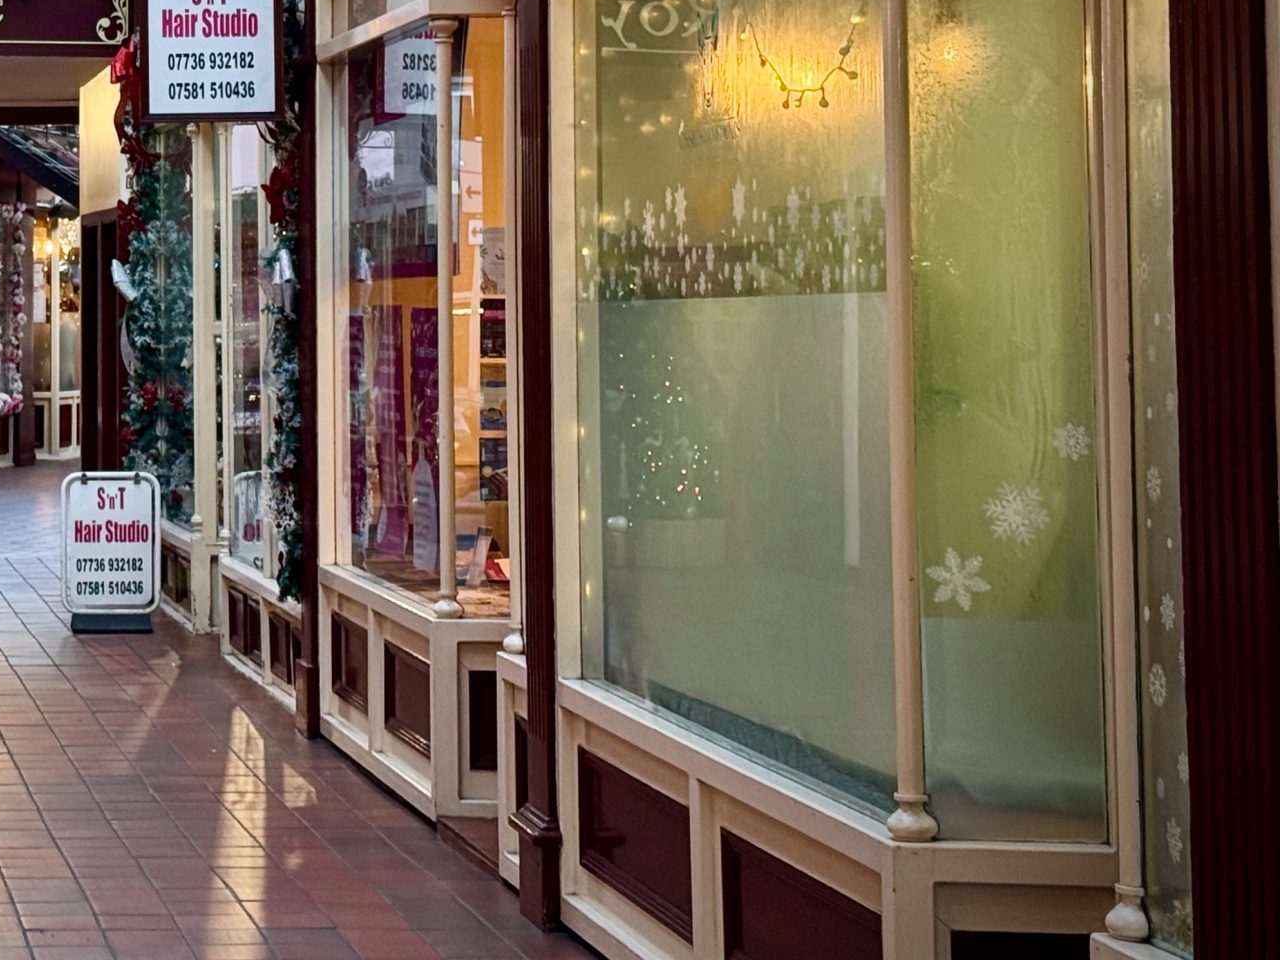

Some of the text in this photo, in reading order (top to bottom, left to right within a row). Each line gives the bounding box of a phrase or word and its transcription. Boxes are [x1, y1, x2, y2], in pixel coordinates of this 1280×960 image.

[161, 7, 259, 38] Hair Studio
[167, 51, 255, 71] 07736 932182
[168, 80, 256, 100] 07581 510436
[74, 519, 149, 543] Hair Studio
[76, 557, 144, 572] 07736 932182
[76, 580, 144, 595] 07581 510436
